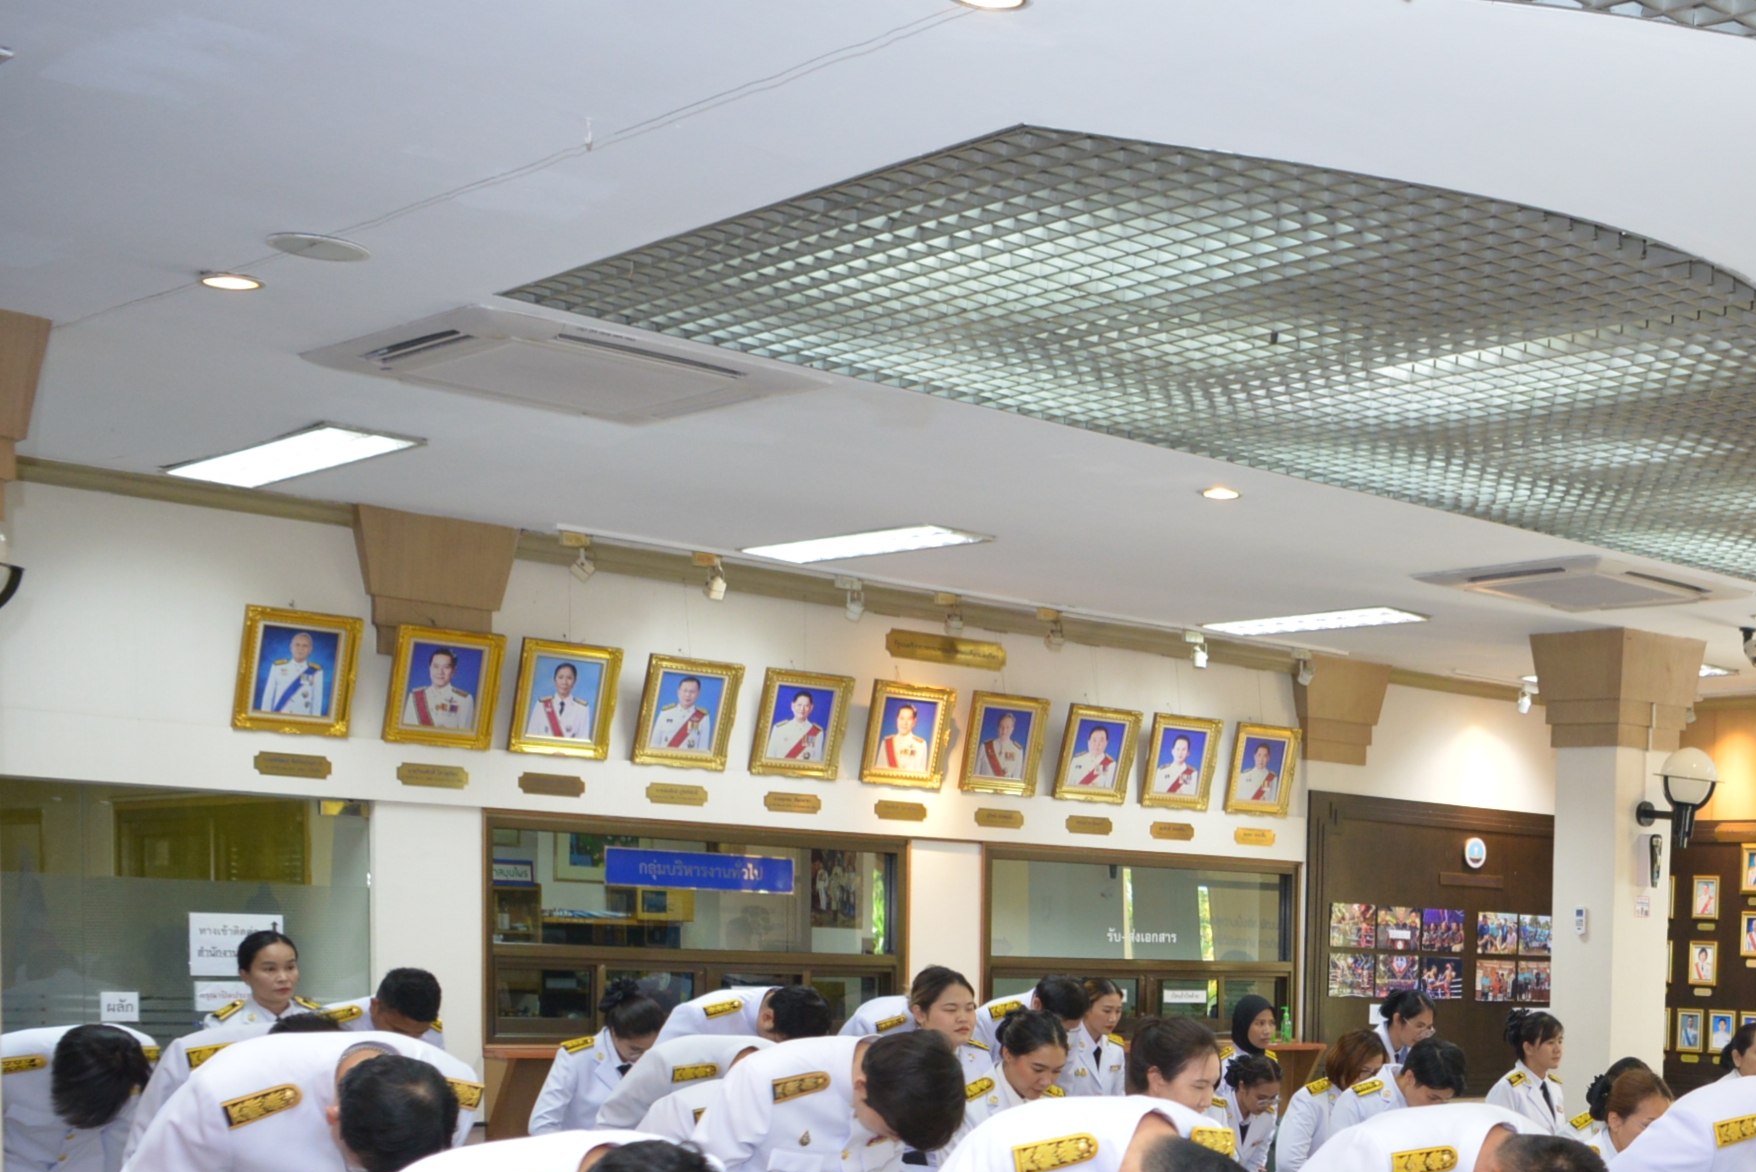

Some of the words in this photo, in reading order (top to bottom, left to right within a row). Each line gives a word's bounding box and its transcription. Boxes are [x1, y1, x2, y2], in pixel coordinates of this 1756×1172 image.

[638, 858, 764, 881] กลุ่มบริหารงานทั่วไป
[1106, 926, 1177, 944] รับ-ส่งเอกสาร
[106, 998, 134, 1013] ผลัก
